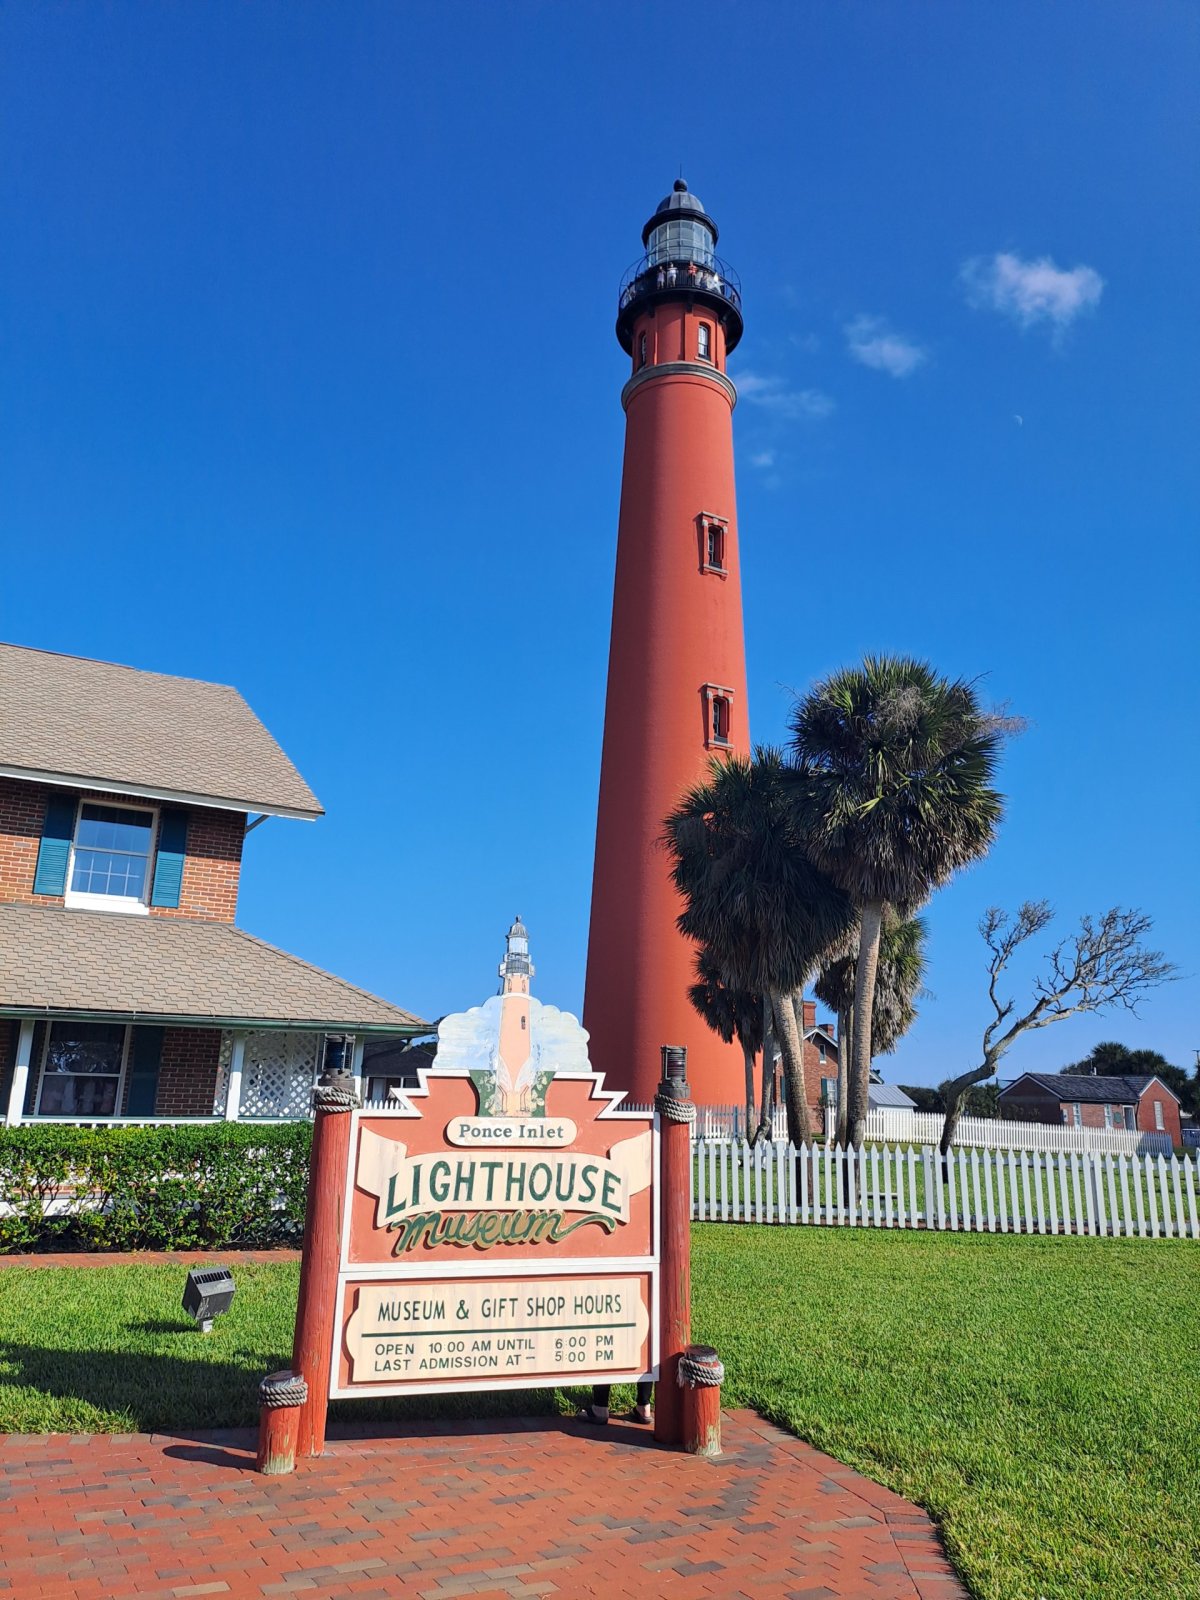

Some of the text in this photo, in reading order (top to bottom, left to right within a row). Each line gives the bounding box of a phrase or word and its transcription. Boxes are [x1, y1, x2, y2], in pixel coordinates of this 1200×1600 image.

[459, 1123, 564, 1139] Ponce Inlet
[385, 1160, 622, 1219] LIGHTHOUSE
[377, 1294, 622, 1322] MUSEUM & GIFT SHOP HOURS
[374, 1343, 415, 1356] OPEN
[471, 1340, 492, 1352] AM
[497, 1338, 536, 1351] UNTIL
[595, 1334, 614, 1346] PM
[374, 1359, 411, 1372] LAST
[418, 1355, 498, 1370] ADMISSION
[505, 1354, 522, 1366] AT
[595, 1349, 614, 1362] PM
